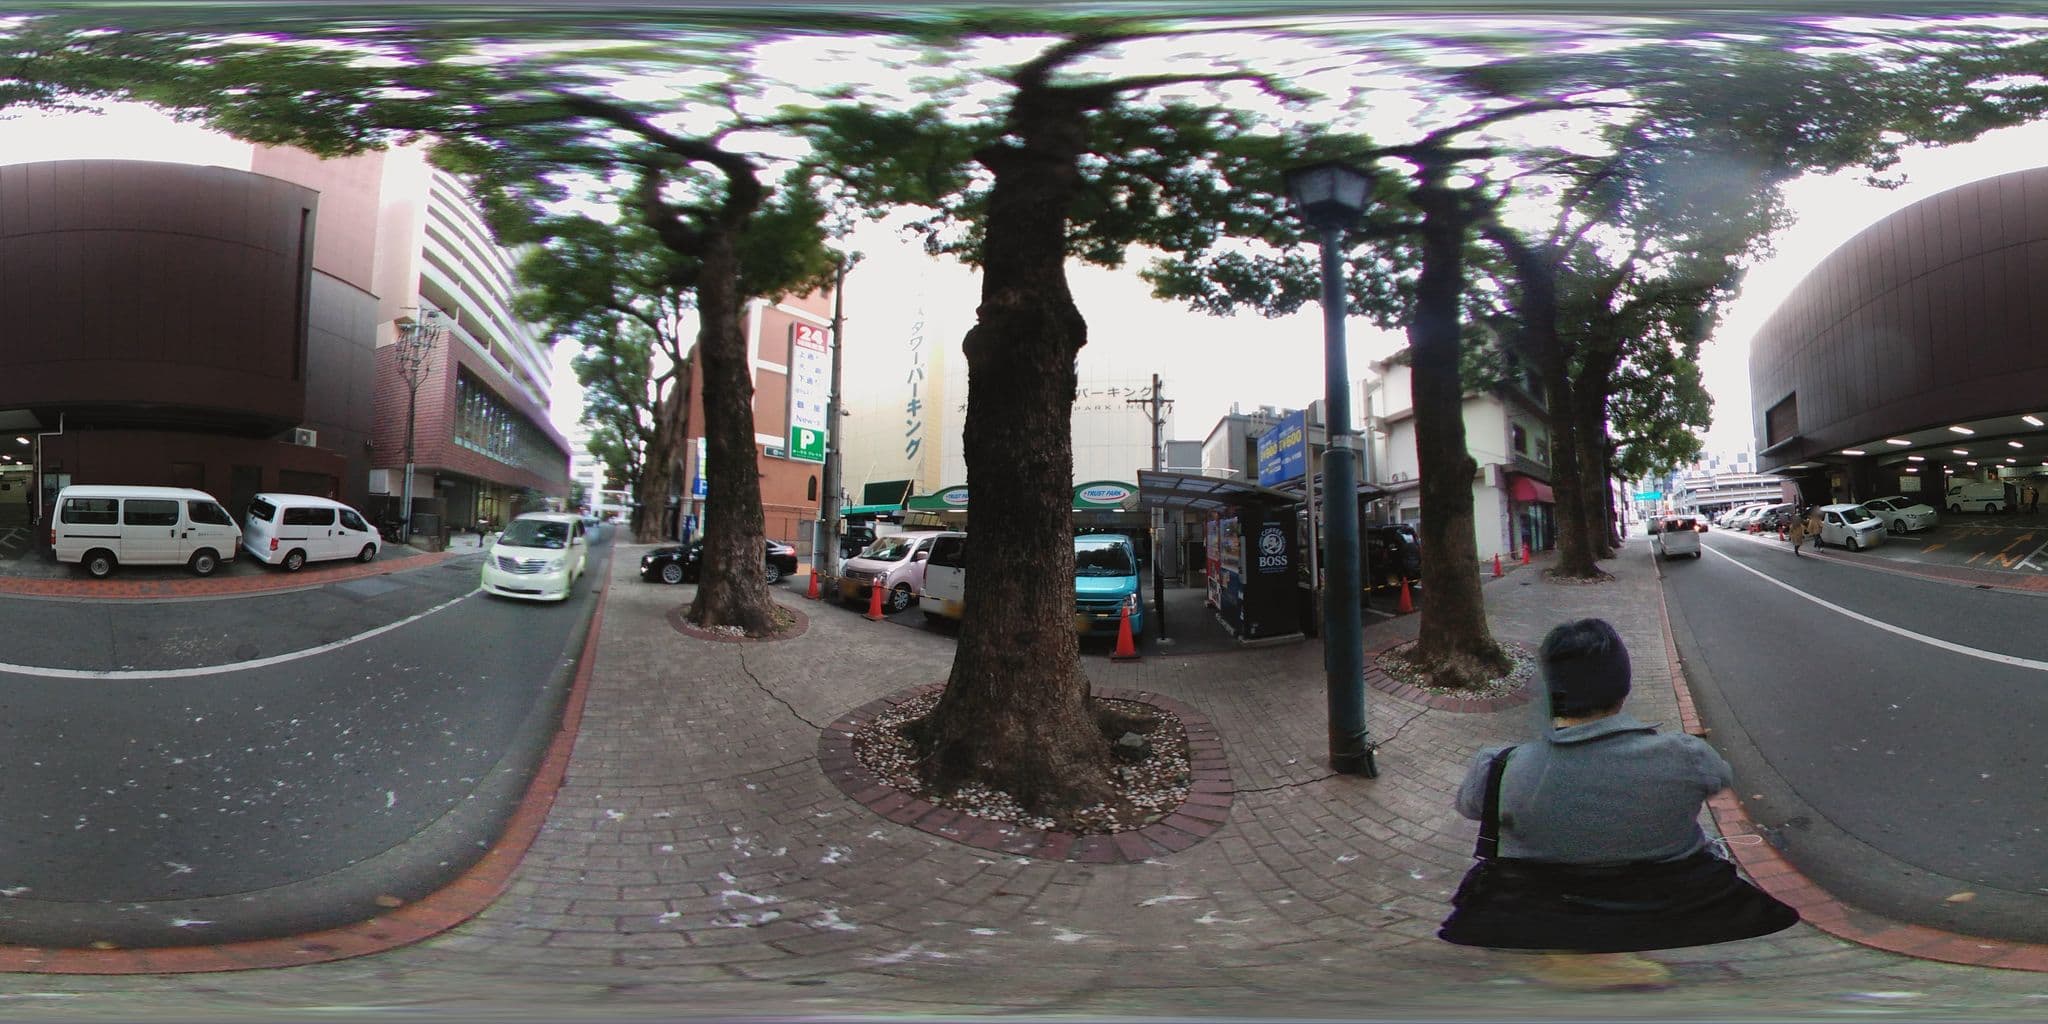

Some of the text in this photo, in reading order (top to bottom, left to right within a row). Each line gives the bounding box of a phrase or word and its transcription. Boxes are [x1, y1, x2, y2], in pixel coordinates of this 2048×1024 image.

[799, 326, 824, 345] 24
[800, 429, 816, 450] P
[1259, 555, 1288, 567] BOSS
